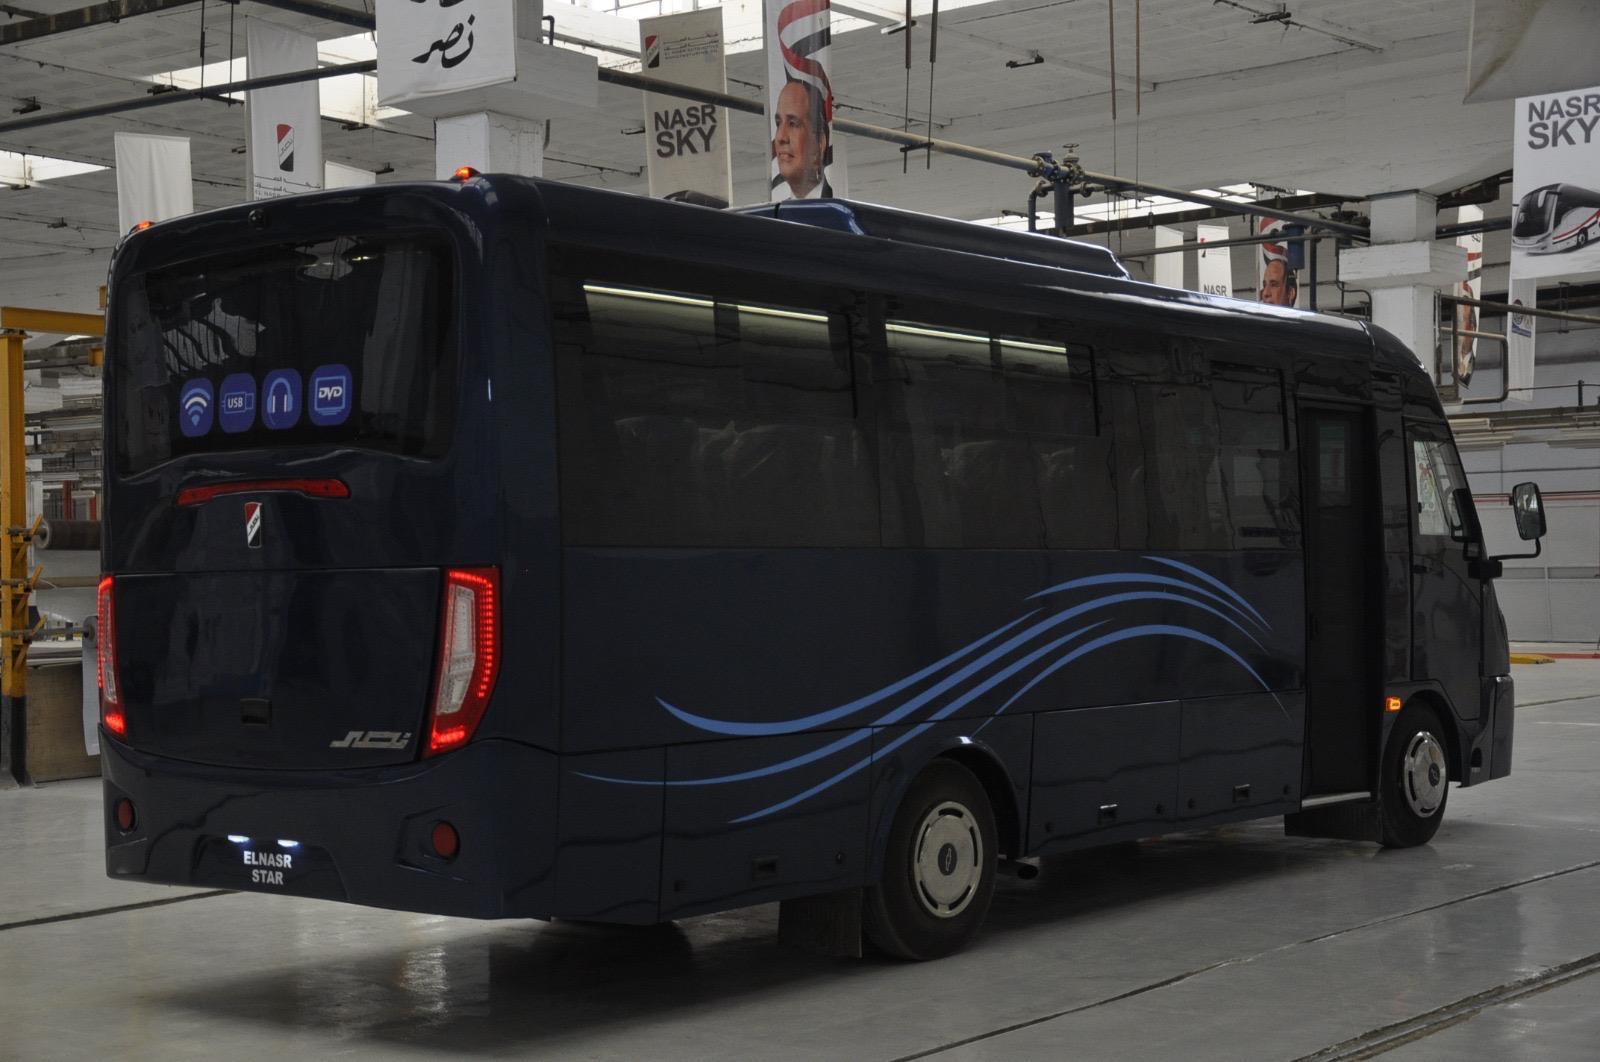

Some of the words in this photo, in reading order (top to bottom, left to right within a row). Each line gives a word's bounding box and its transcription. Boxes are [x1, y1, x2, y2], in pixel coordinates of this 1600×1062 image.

[410, 14, 475, 68] نصر
[654, 104, 717, 131] NASR
[1528, 94, 1600, 122] NASR
[656, 124, 717, 158] SKY
[1528, 115, 1600, 150] SKY
[1203, 284, 1227, 297] NASR
[227, 396, 243, 409] USB
[318, 386, 343, 401] DVD
[243, 850, 292, 868] ELNASR
[252, 868, 284, 885] STAR
